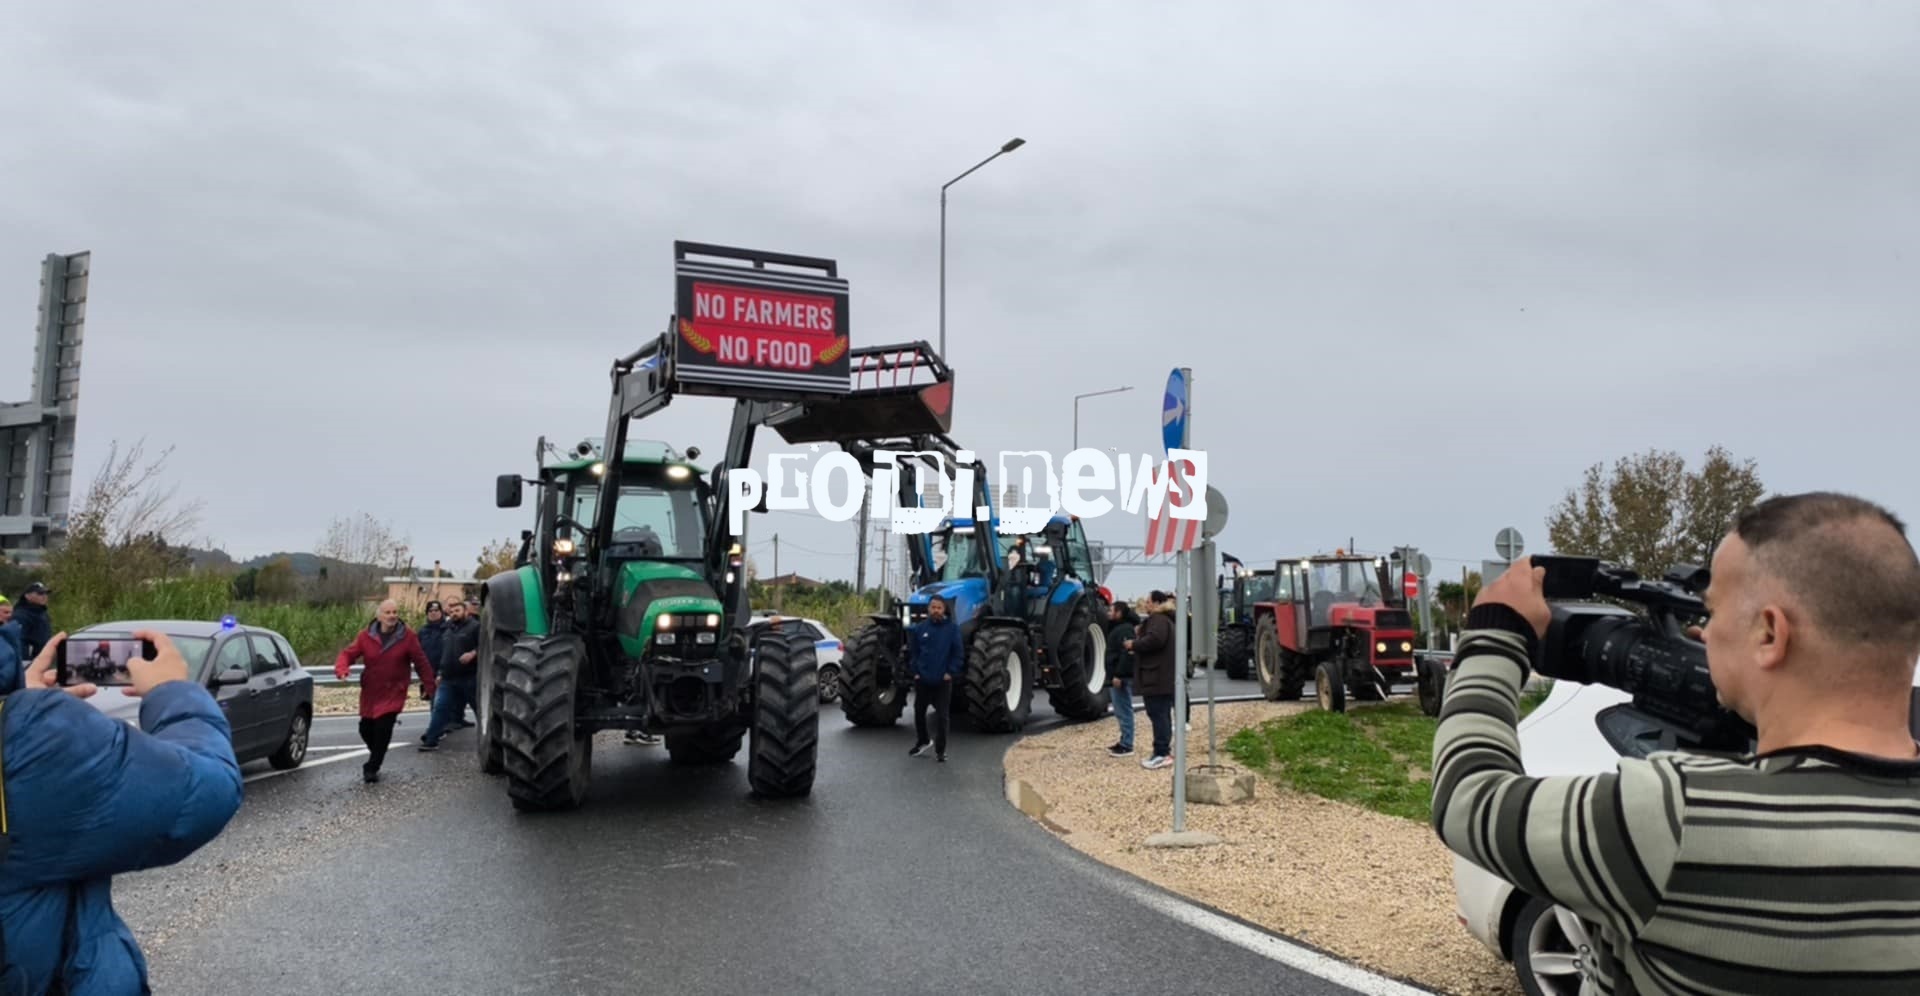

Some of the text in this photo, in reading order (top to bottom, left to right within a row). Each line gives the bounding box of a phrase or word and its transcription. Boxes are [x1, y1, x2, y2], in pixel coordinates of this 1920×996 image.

[695, 293, 833, 331] NO FARMERS
[719, 335, 811, 367] NO FOOD
